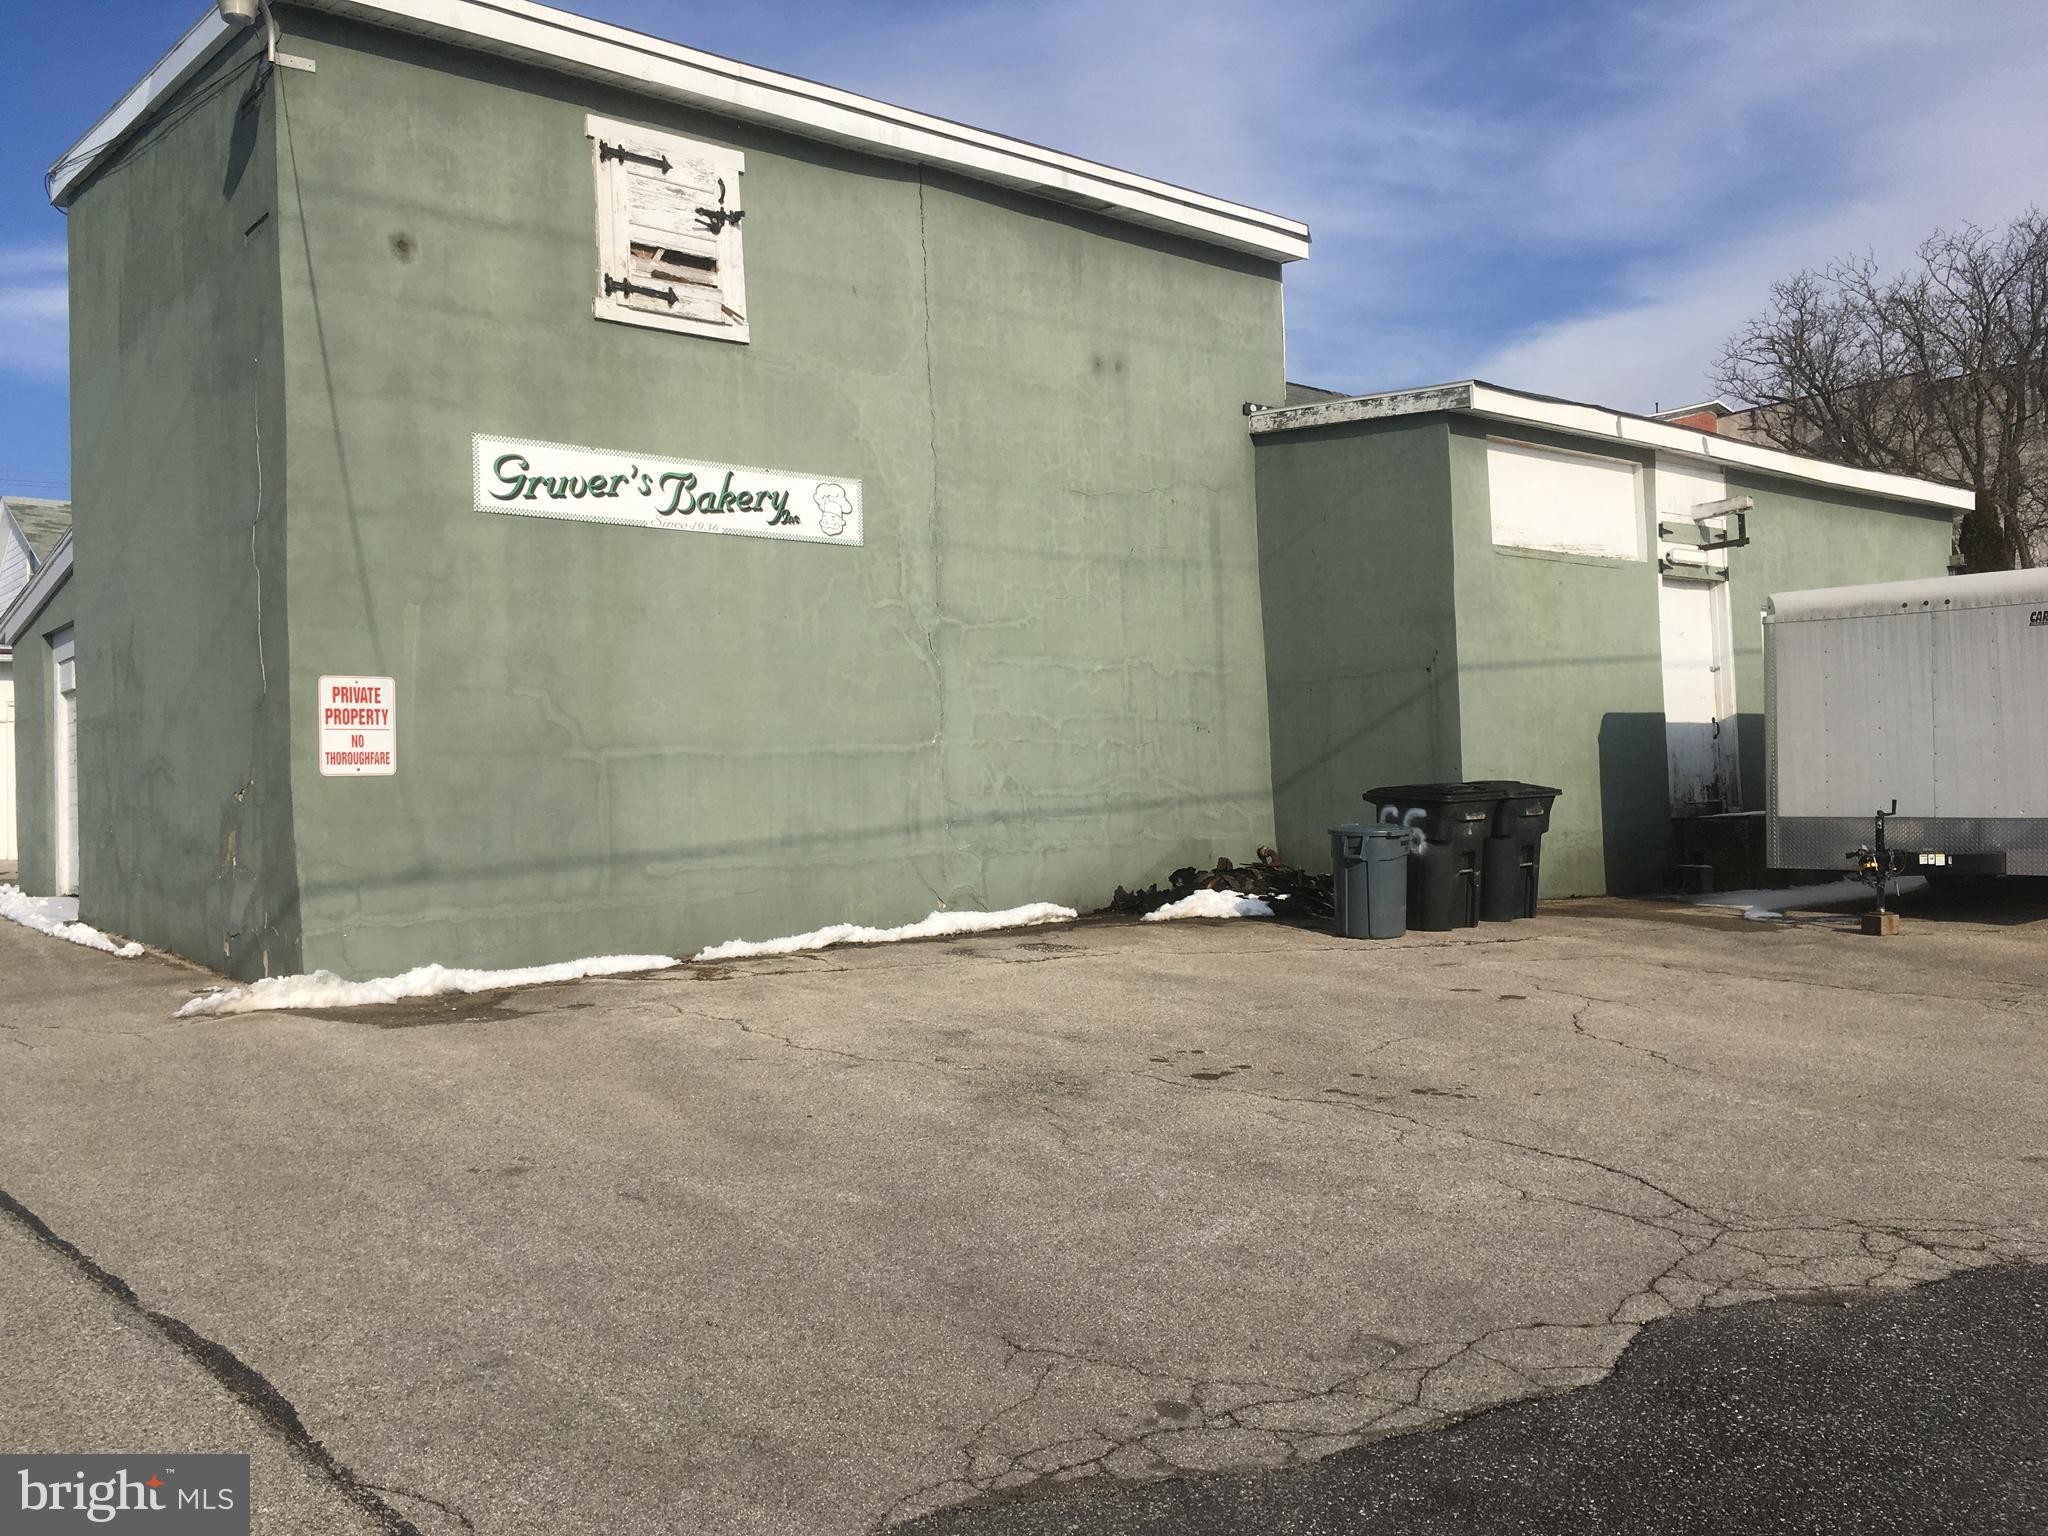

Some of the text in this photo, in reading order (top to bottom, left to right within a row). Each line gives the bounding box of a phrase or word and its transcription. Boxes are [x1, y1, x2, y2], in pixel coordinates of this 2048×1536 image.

[488, 454, 653, 500] Gruver's
[655, 471, 789, 526] Bakery
[650, 514, 688, 530] Since
[332, 686, 381, 704] PRIVATE
[325, 708, 388, 725] PROPERTY
[351, 734, 365, 748] NO
[325, 751, 391, 765] THOROUGHFARE
